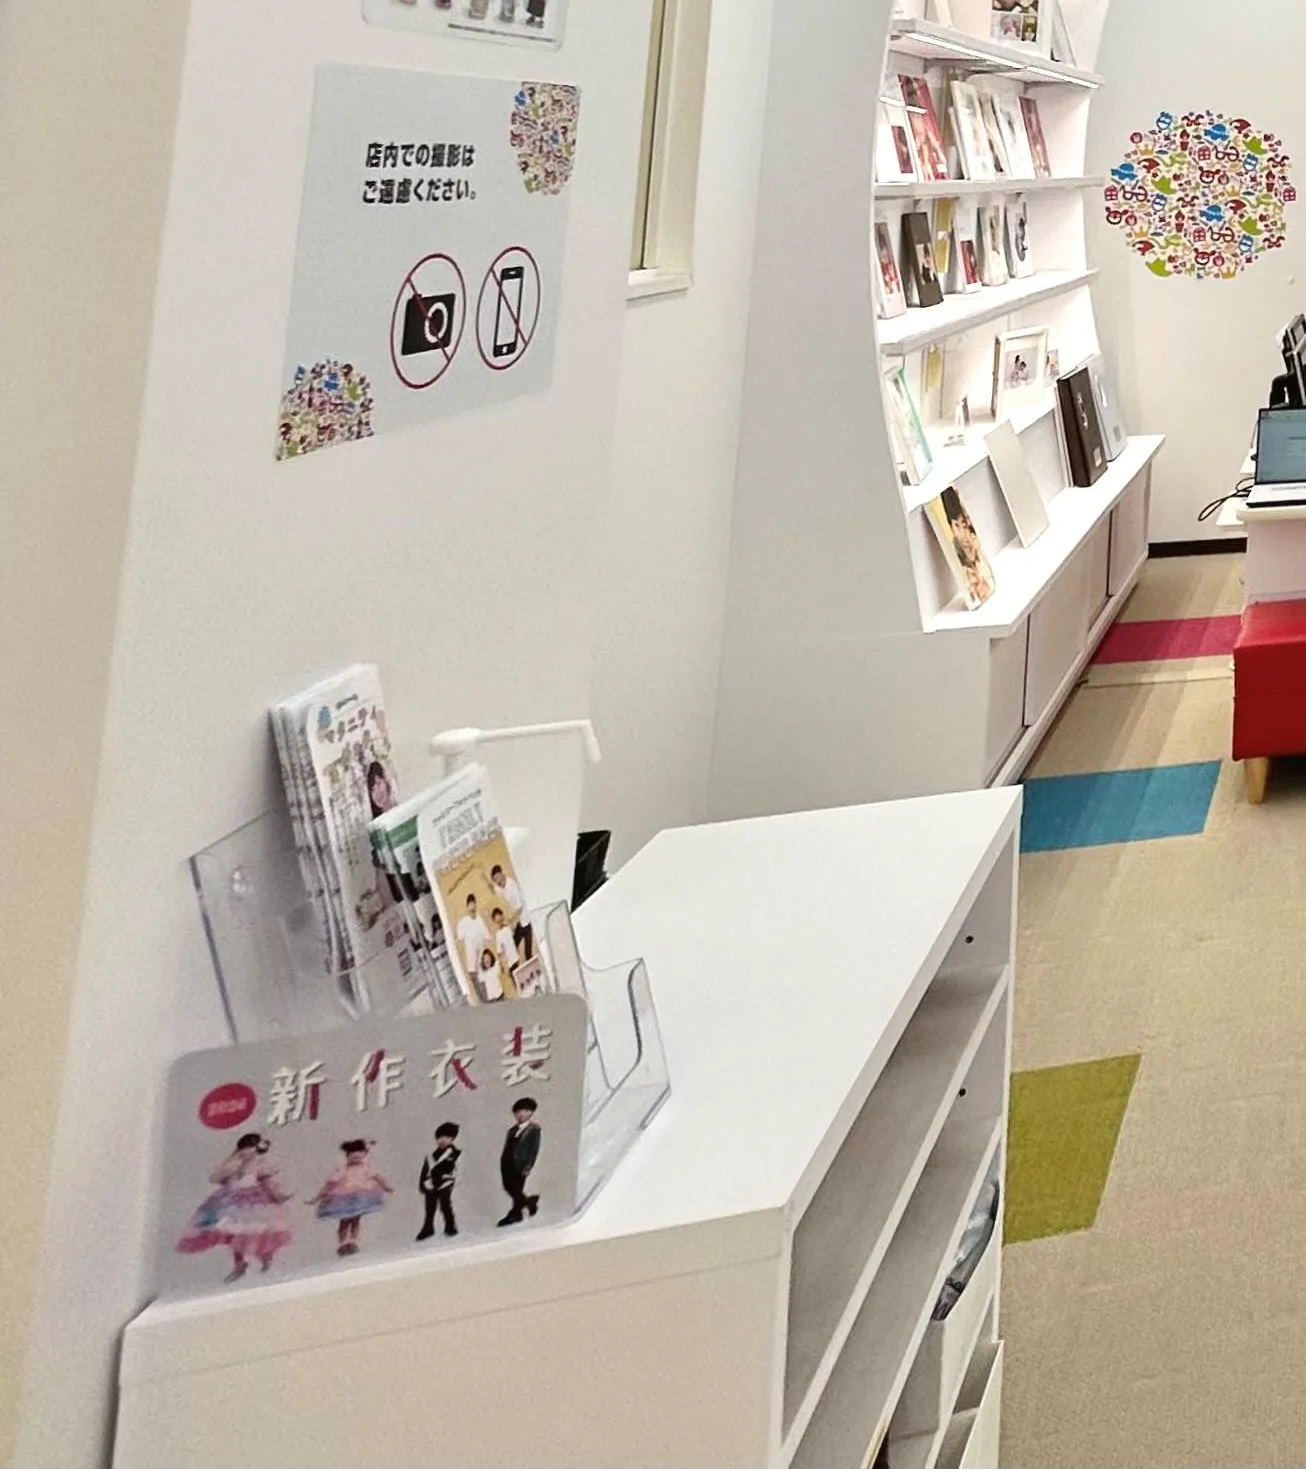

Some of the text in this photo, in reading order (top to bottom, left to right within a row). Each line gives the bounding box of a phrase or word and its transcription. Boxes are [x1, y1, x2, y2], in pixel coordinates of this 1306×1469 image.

[365, 142, 475, 169] 店内での撮影は
[362, 177, 477, 204] ご遠慮ください。
[267, 1022, 552, 1127] 新作衣装
